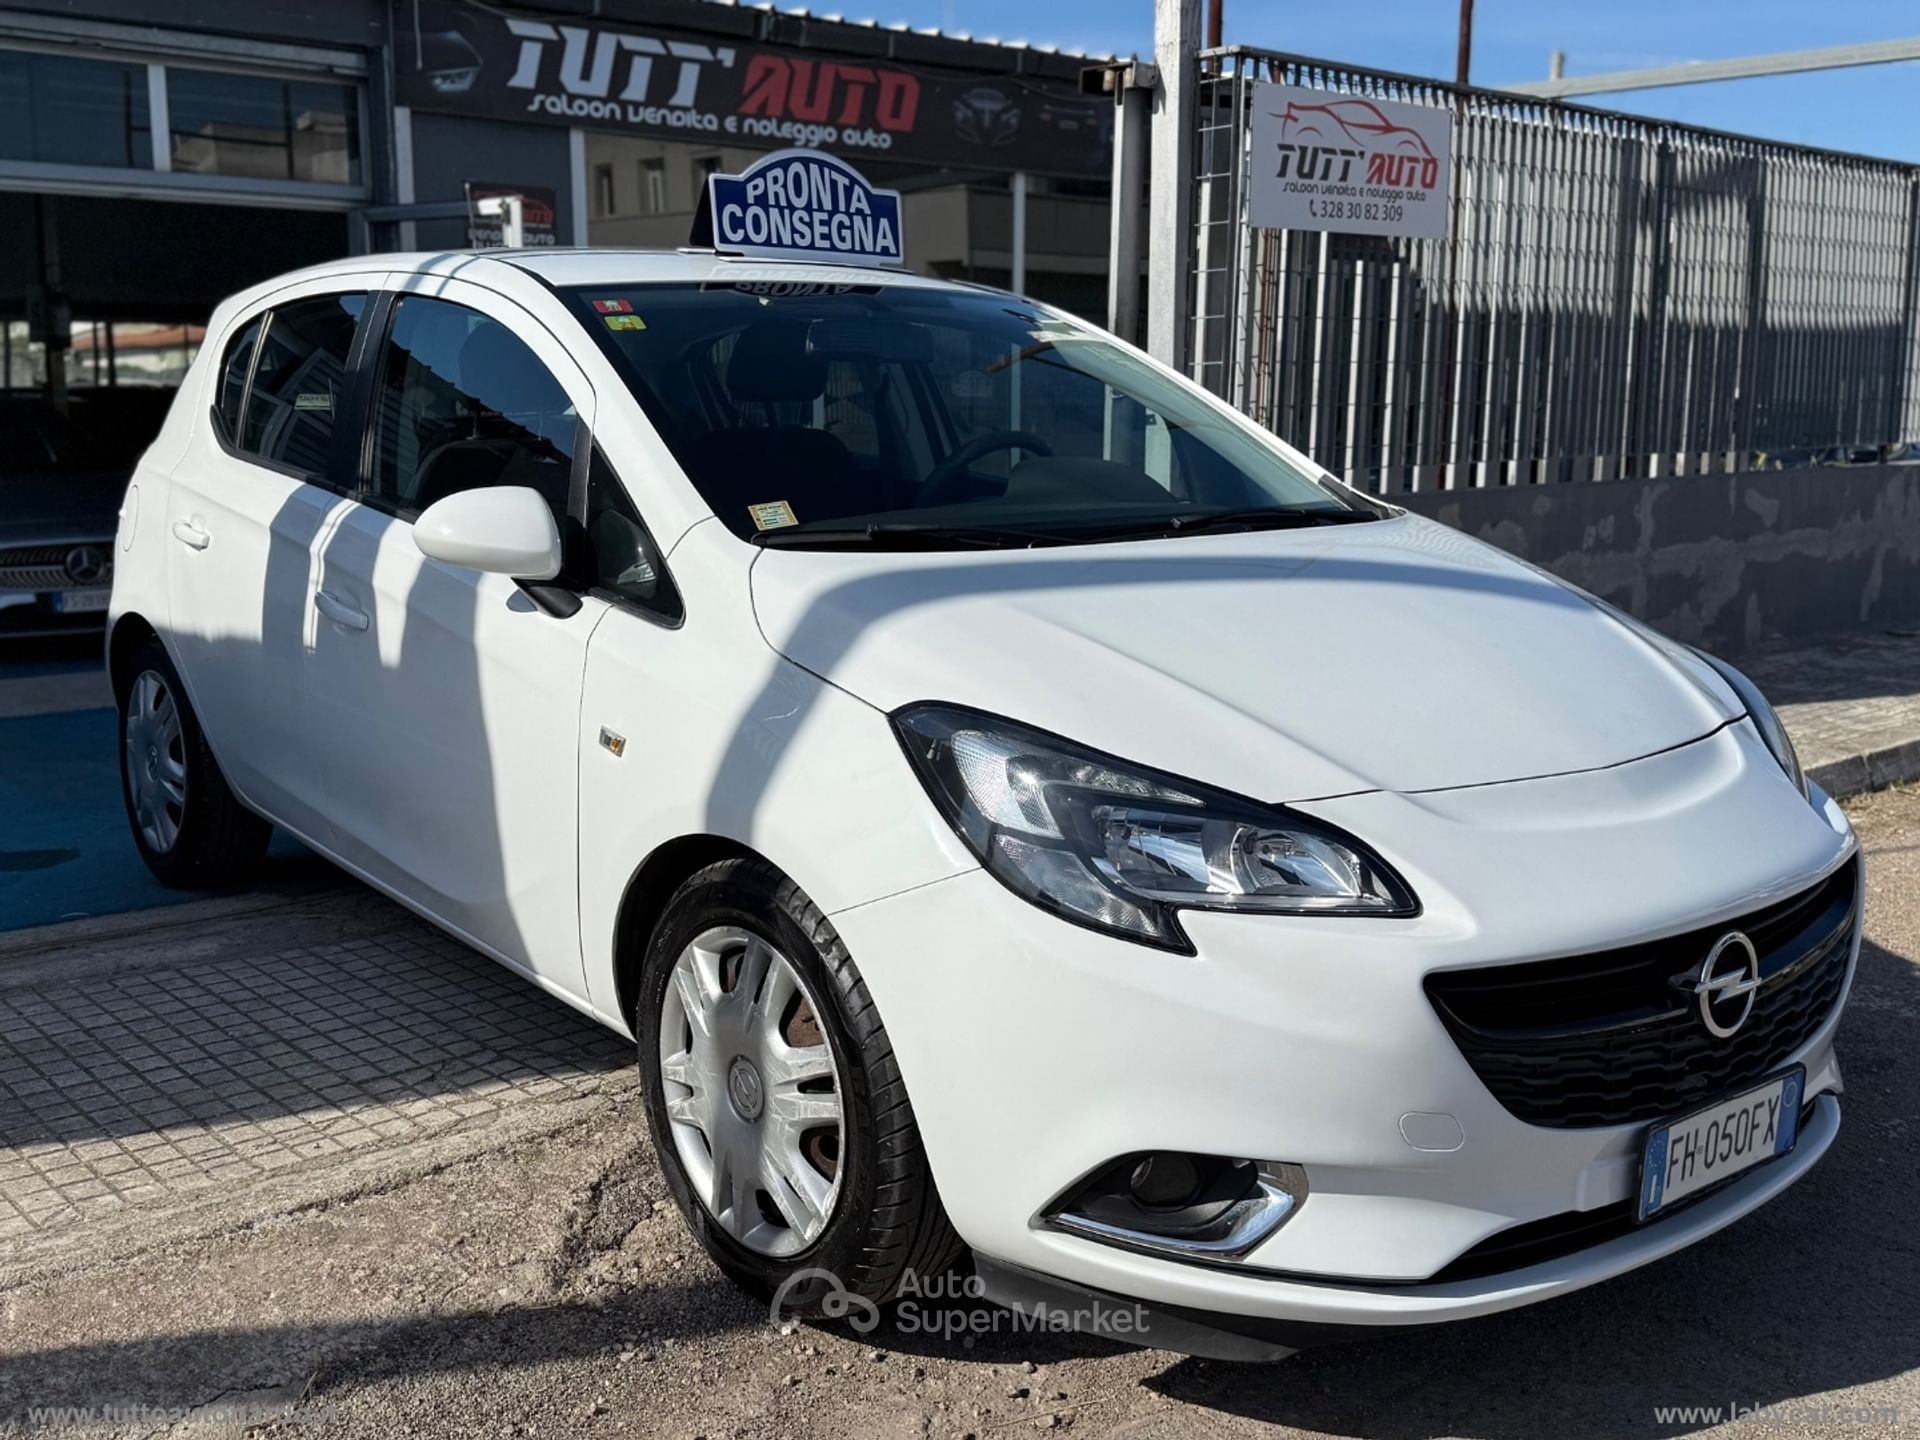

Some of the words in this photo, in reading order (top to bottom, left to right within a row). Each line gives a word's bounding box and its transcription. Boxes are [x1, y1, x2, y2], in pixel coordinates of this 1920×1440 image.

[505, 18, 736, 107] TUTT'
[738, 53, 920, 132] AUTO
[842, 128, 892, 148] auto
[746, 161, 871, 215] PRONTA
[1276, 143, 1366, 182] TUTT'
[1366, 153, 1438, 189] AUTO
[722, 203, 897, 254] CONSEGNA
[1320, 201, 1344, 218] 328
[1347, 202, 1362, 220] 30
[1364, 203, 1379, 221] 82
[1382, 205, 1403, 222] 309
